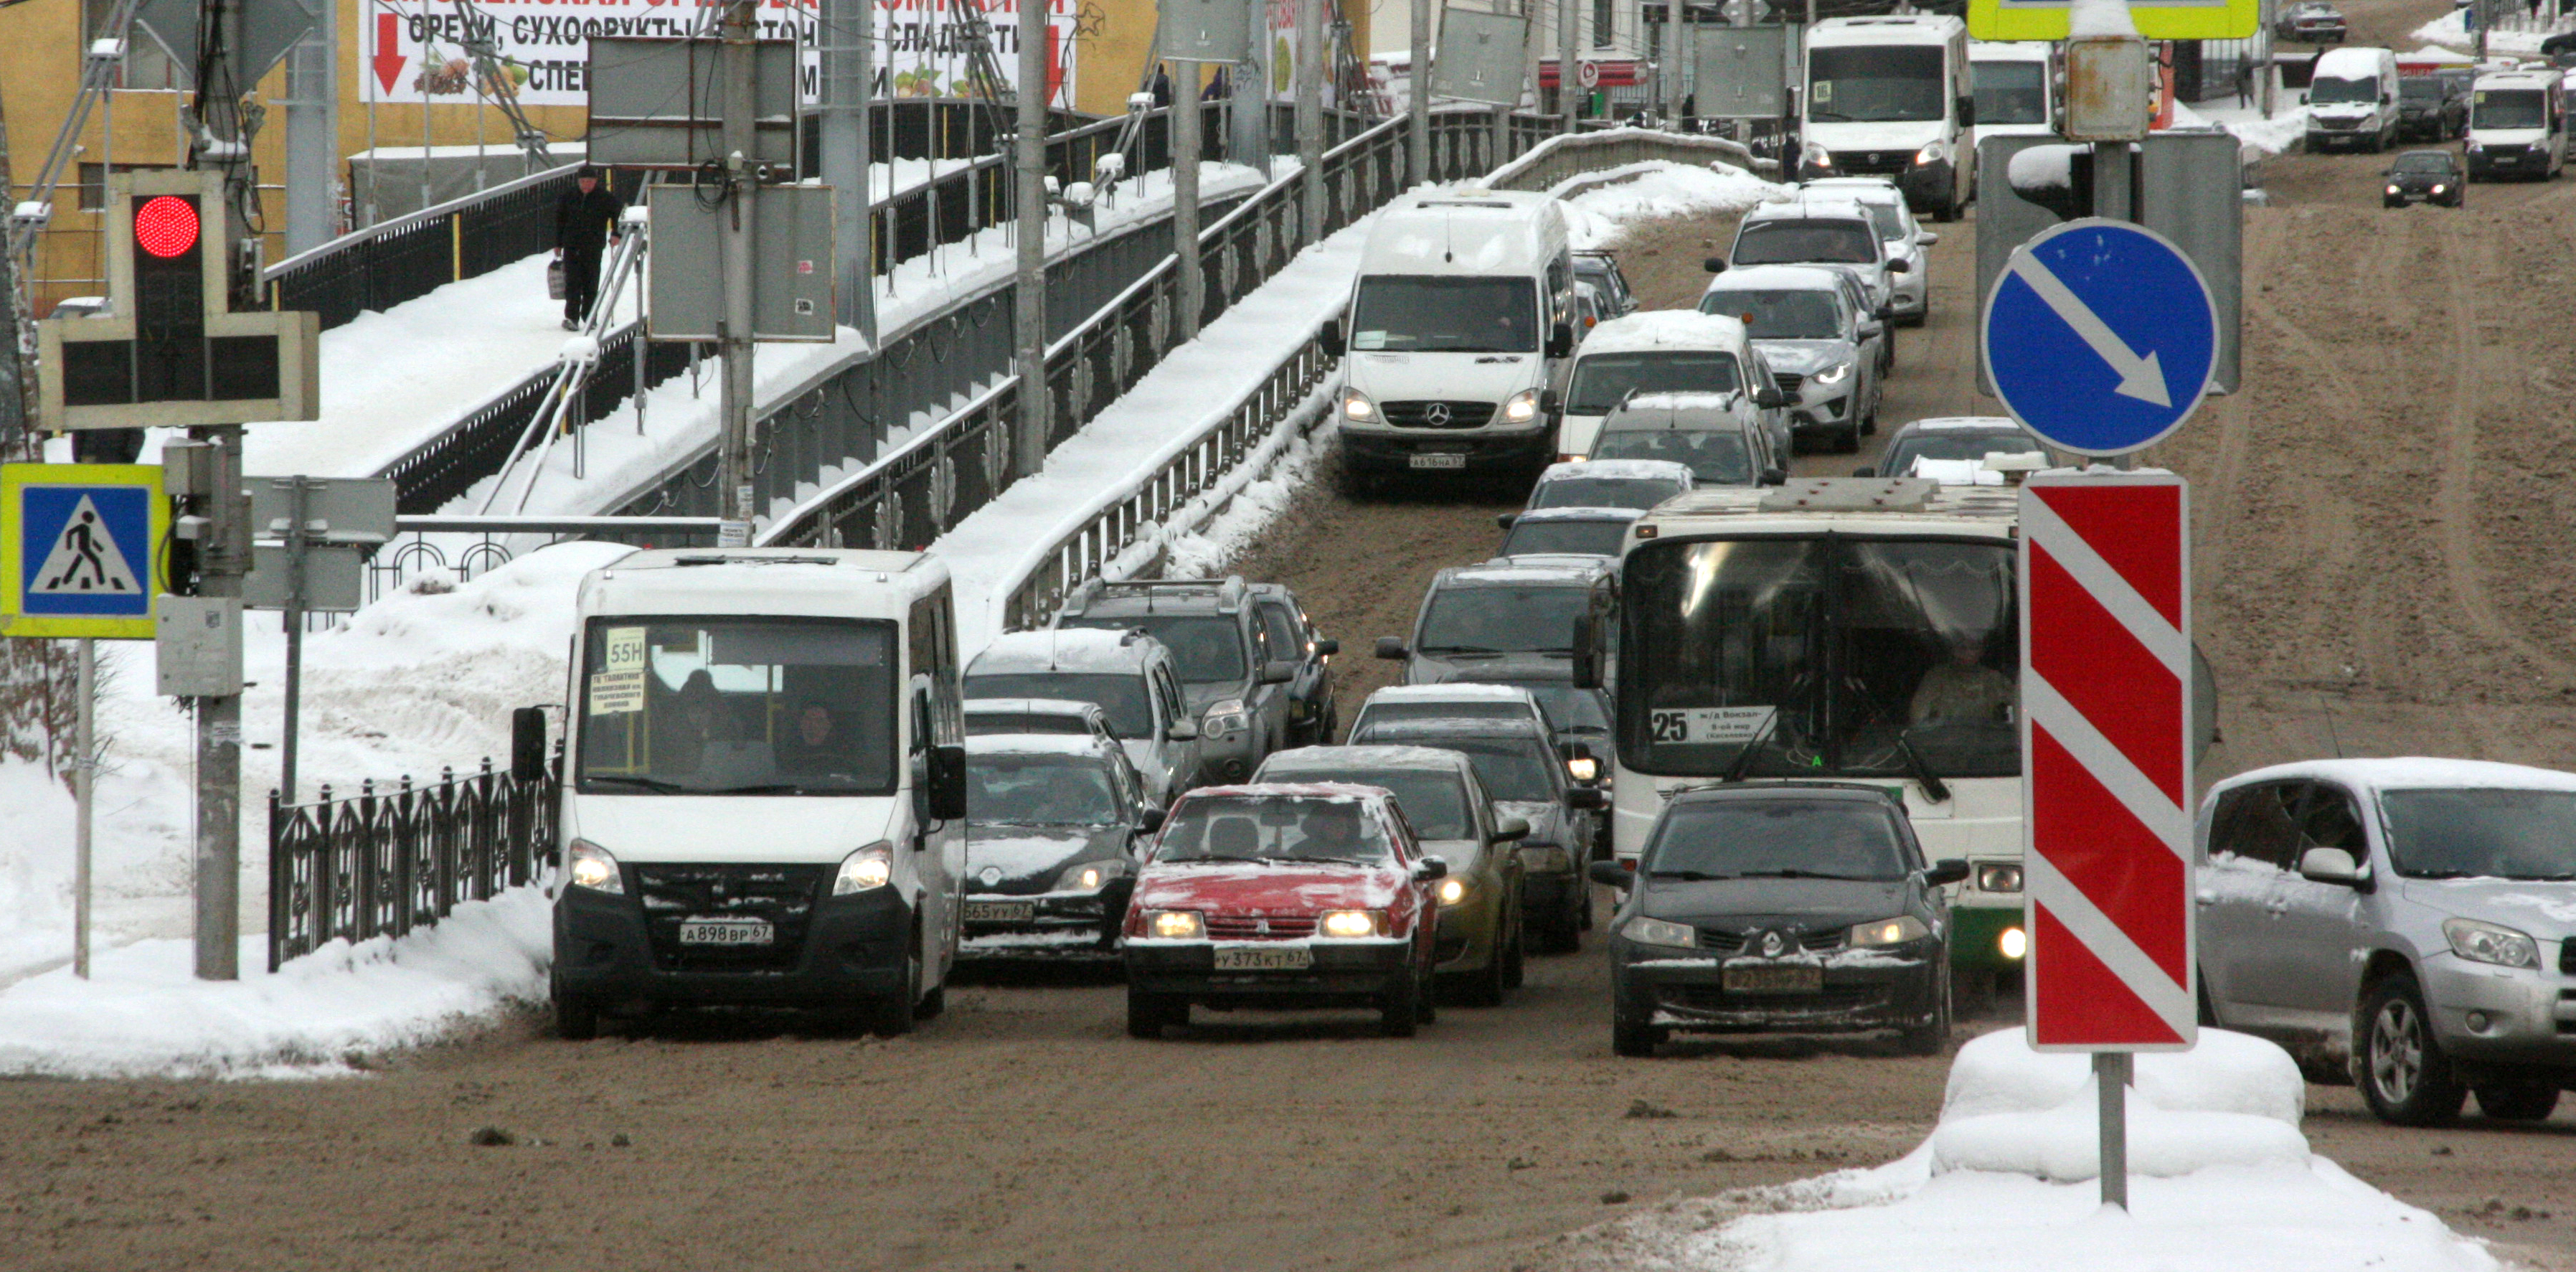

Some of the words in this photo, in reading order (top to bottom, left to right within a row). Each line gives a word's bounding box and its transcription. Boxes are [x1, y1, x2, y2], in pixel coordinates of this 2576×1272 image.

[610, 641, 643, 664] 55Н
[1653, 712, 1687, 741] 25
[753, 926, 768, 938] 67
